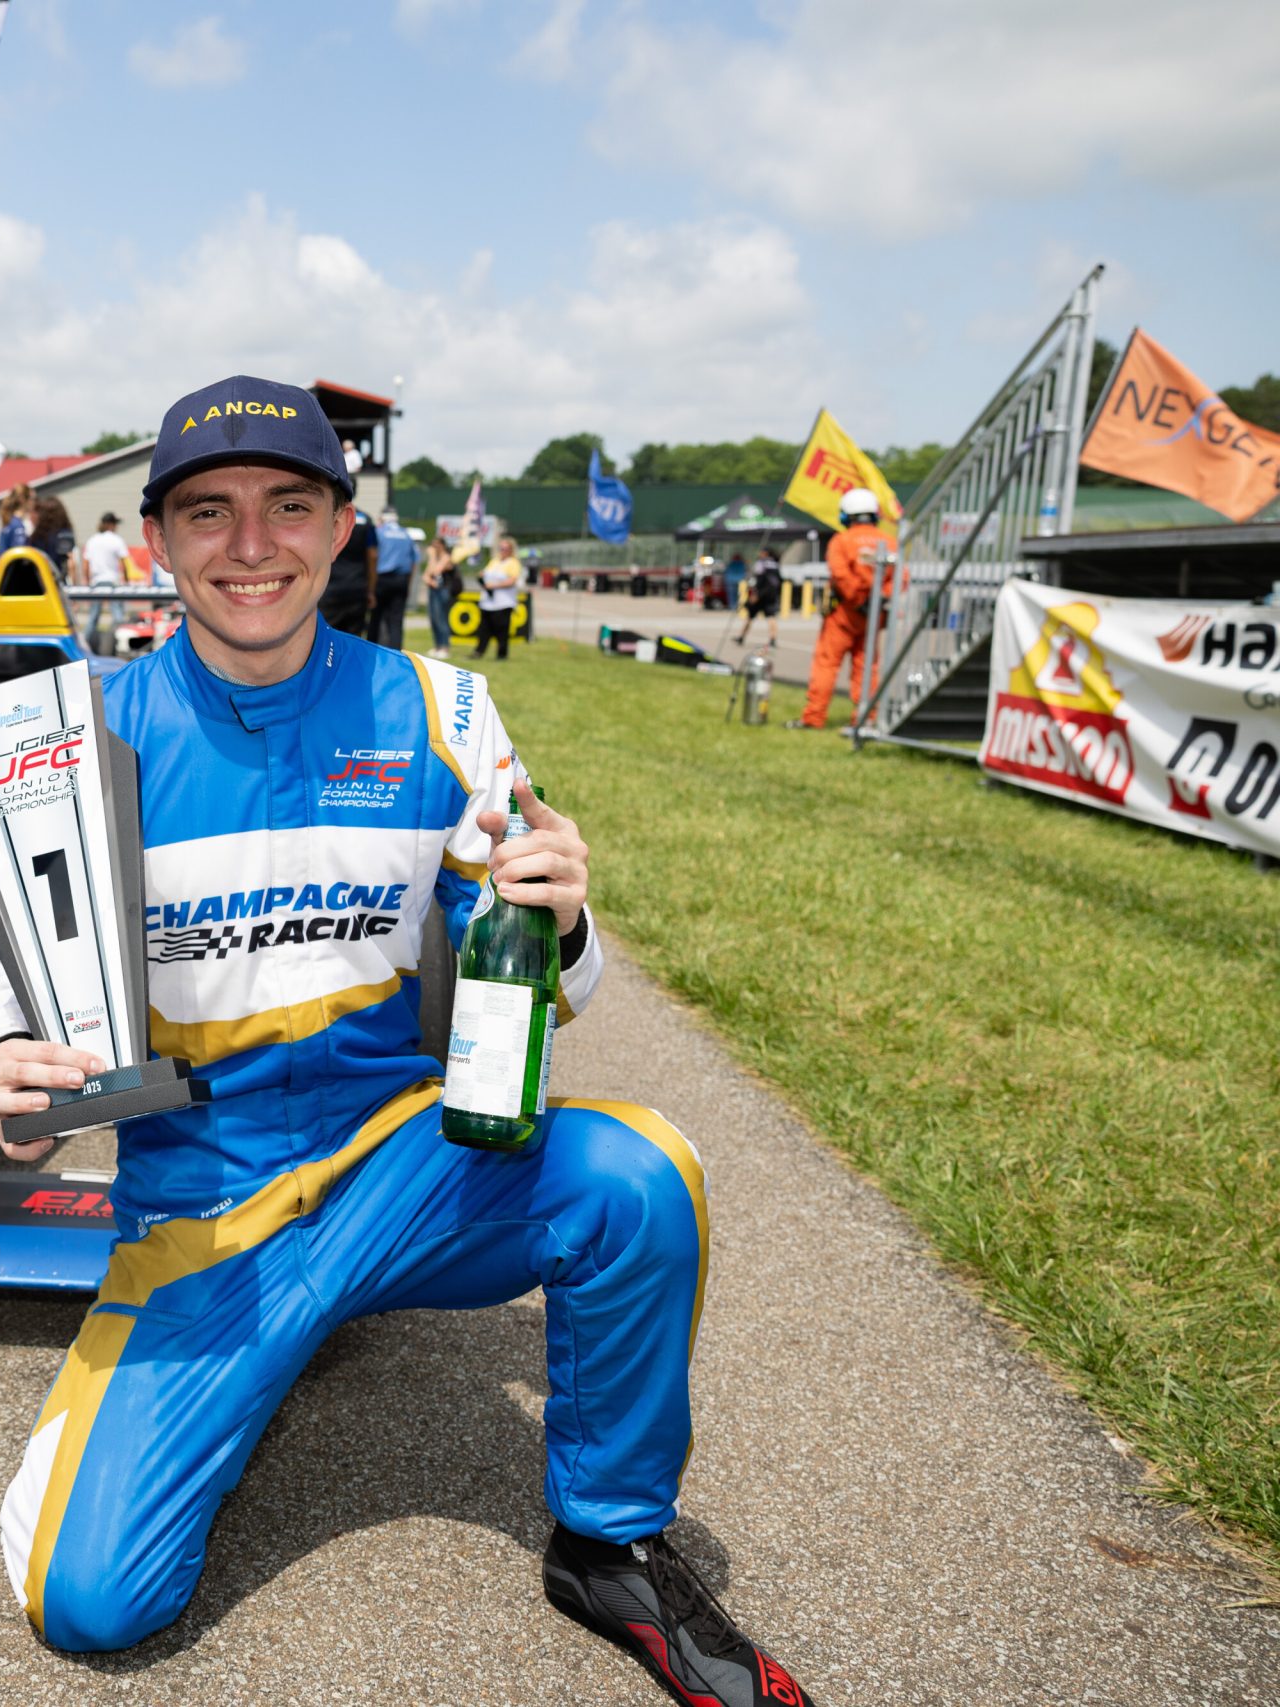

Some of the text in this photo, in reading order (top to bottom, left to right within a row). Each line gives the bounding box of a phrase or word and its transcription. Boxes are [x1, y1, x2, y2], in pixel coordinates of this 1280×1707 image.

[203, 400, 298, 422] ANCAP
[335, 747, 415, 761] LIGIER
[990, 706, 1130, 791] MISSION
[327, 760, 410, 784] JFC
[321, 790, 395, 801] FORMULA
[324, 782, 400, 792] JUNIOR
[318, 798, 393, 809] CHAMPIONSHIP
[31, 848, 80, 943] 1
[145, 881, 410, 933] CHAMPAGNE
[248, 913, 399, 954] RACING
[82, 1079, 102, 1096] 2025
